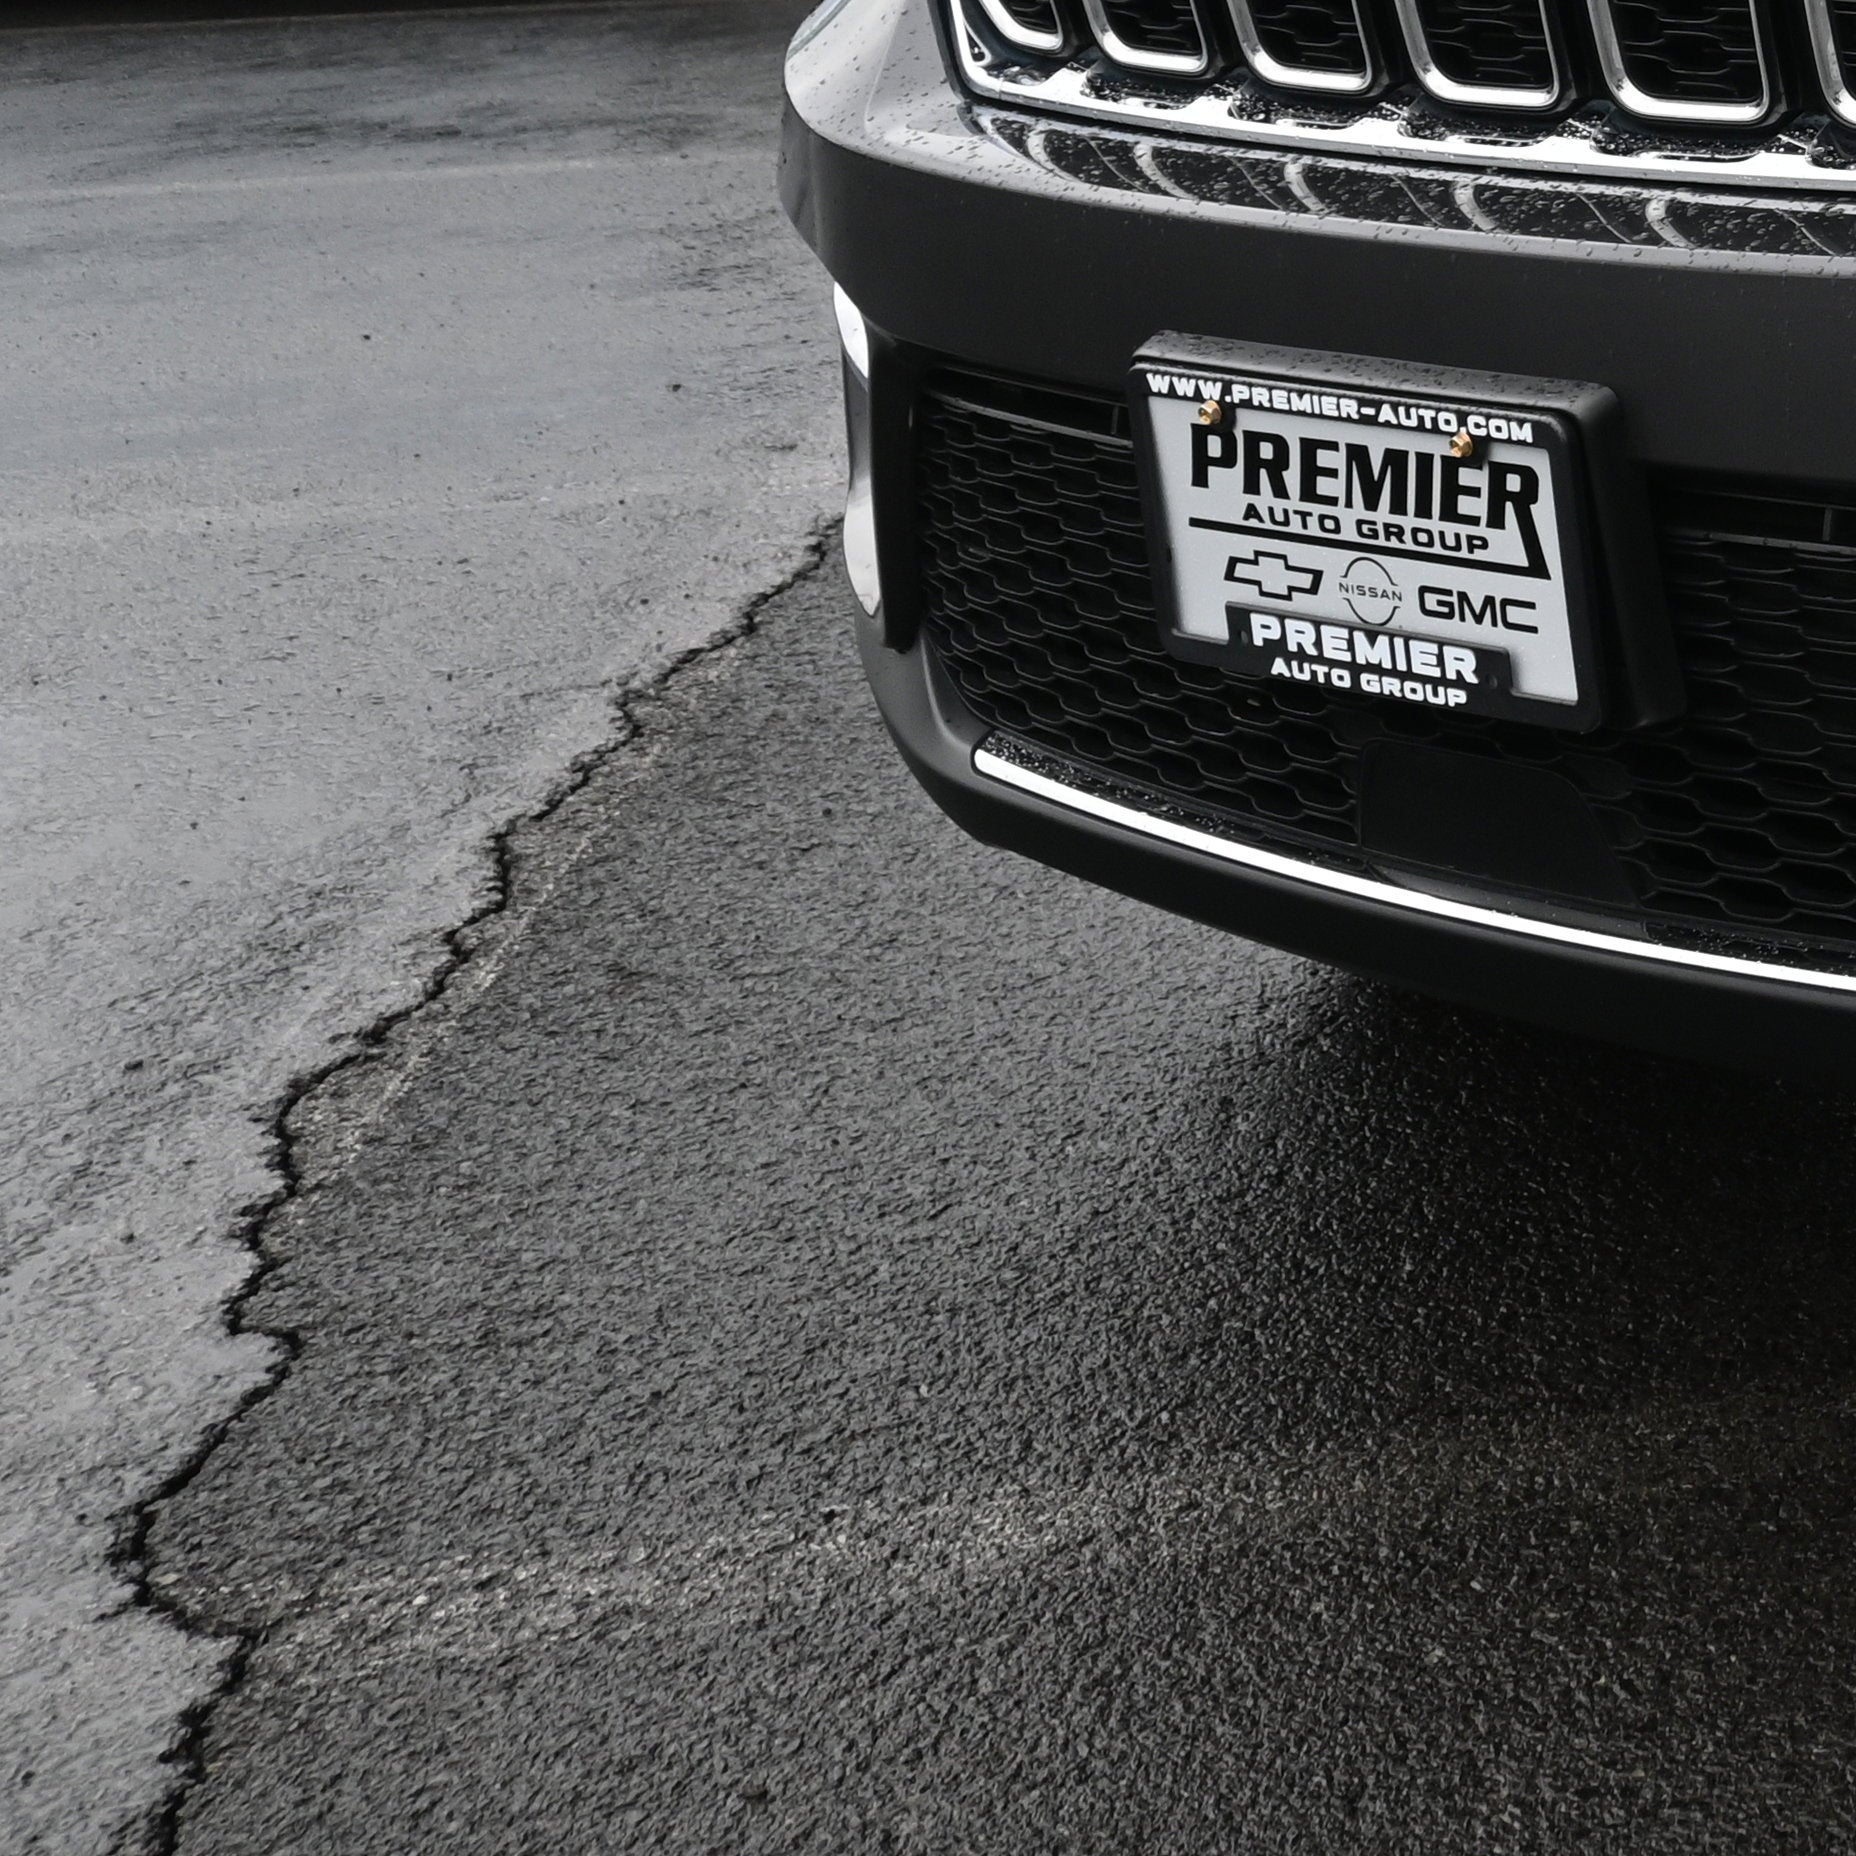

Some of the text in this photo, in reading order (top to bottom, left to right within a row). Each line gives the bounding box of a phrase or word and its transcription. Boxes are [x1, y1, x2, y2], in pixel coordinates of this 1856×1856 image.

[1146, 373, 1533, 443] WWW.PREMIER-AUTO.COM
[1190, 423, 1552, 580] PREMIER
[1242, 503, 1489, 555] AUTO GROUP
[1339, 582, 1402, 603] NISSAN
[1418, 585, 1538, 634] GMC
[1250, 613, 1479, 684] PREMIER
[1271, 658, 1467, 707] AUTO GROUP
